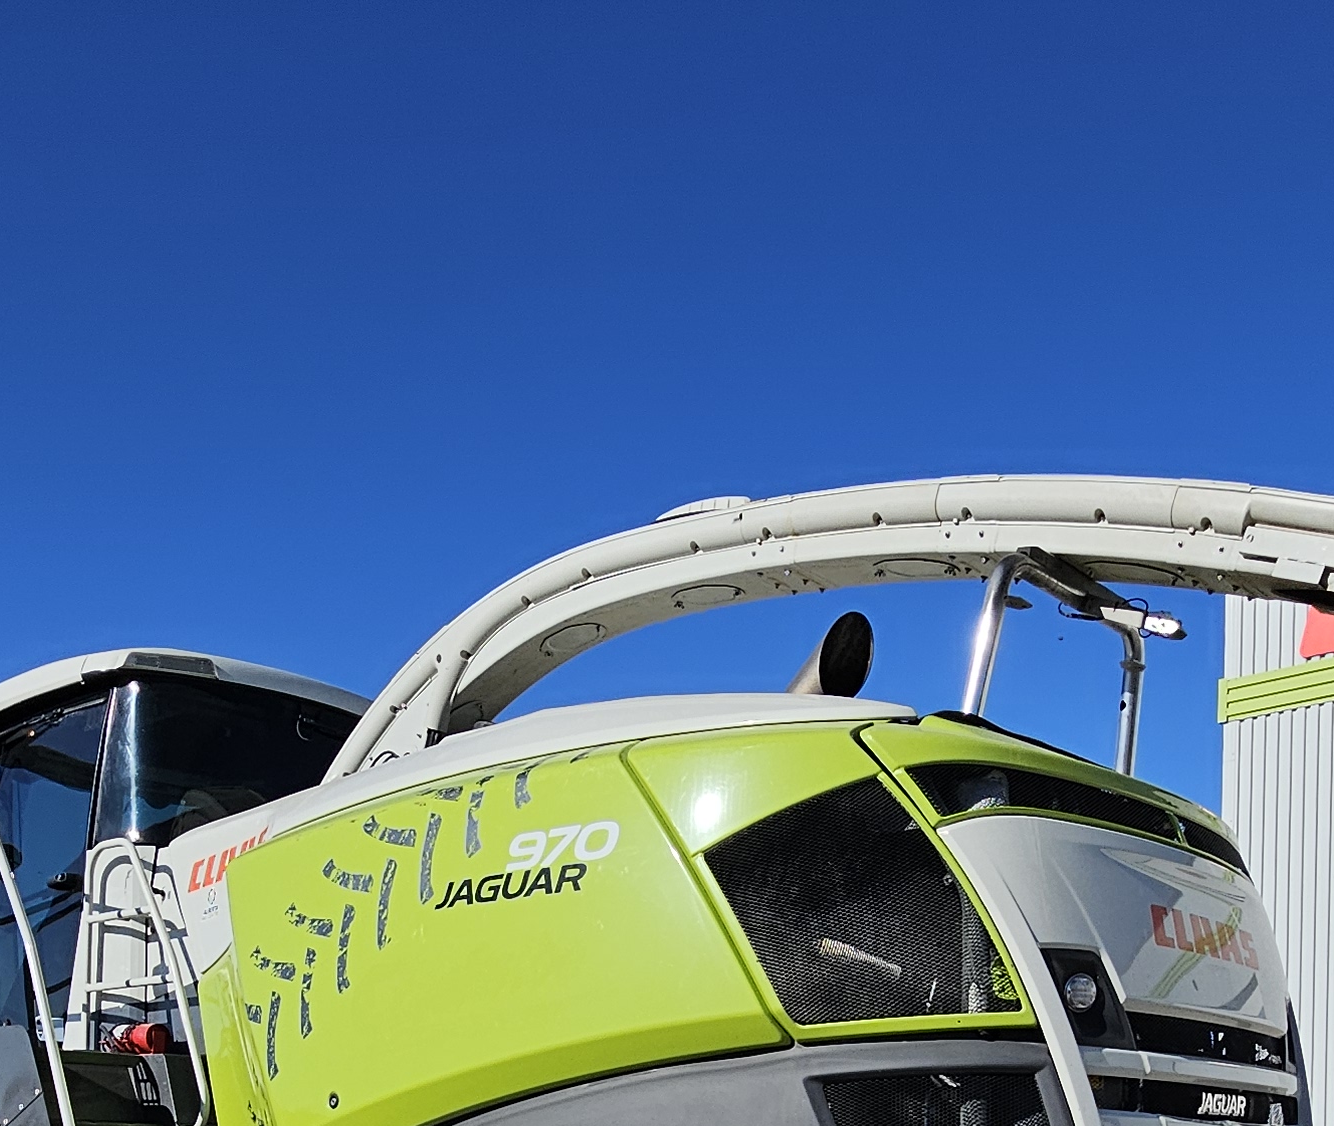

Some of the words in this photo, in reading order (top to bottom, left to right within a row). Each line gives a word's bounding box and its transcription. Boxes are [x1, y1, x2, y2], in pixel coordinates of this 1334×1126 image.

[188, 826, 269, 893] CLA
[505, 821, 620, 872] 970
[434, 863, 588, 910] JAGUAR
[1151, 904, 1259, 970] CLAAS
[1198, 1092, 1246, 1116] JAGUAR
